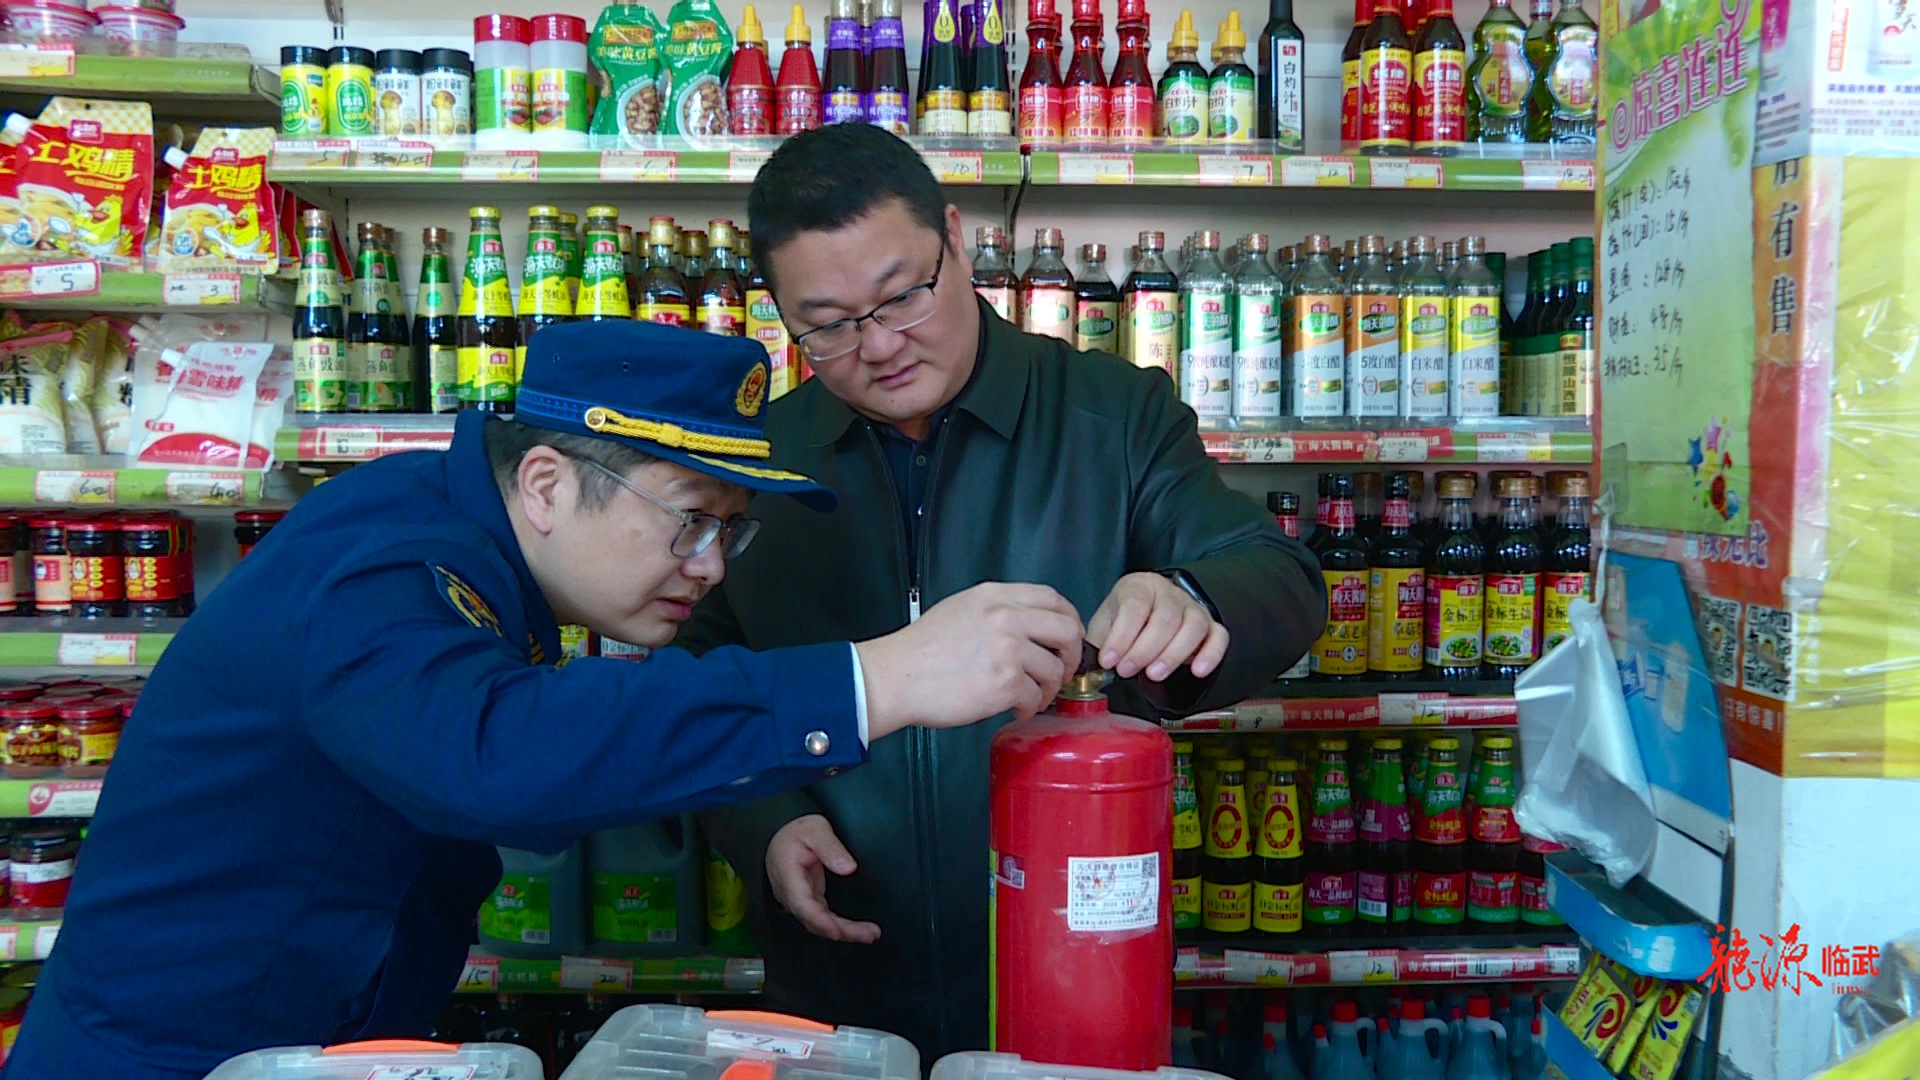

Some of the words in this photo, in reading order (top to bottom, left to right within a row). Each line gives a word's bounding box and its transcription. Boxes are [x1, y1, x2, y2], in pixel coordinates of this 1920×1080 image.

[1283, 61, 1296, 113] 白灼汁
[1630, 28, 1751, 142] 惊喜连连
[29, 140, 137, 183] 土鸡精
[184, 163, 264, 193] 土鸡精
[60, 273, 74, 292] 5
[1264, 449, 1274, 461] 6
